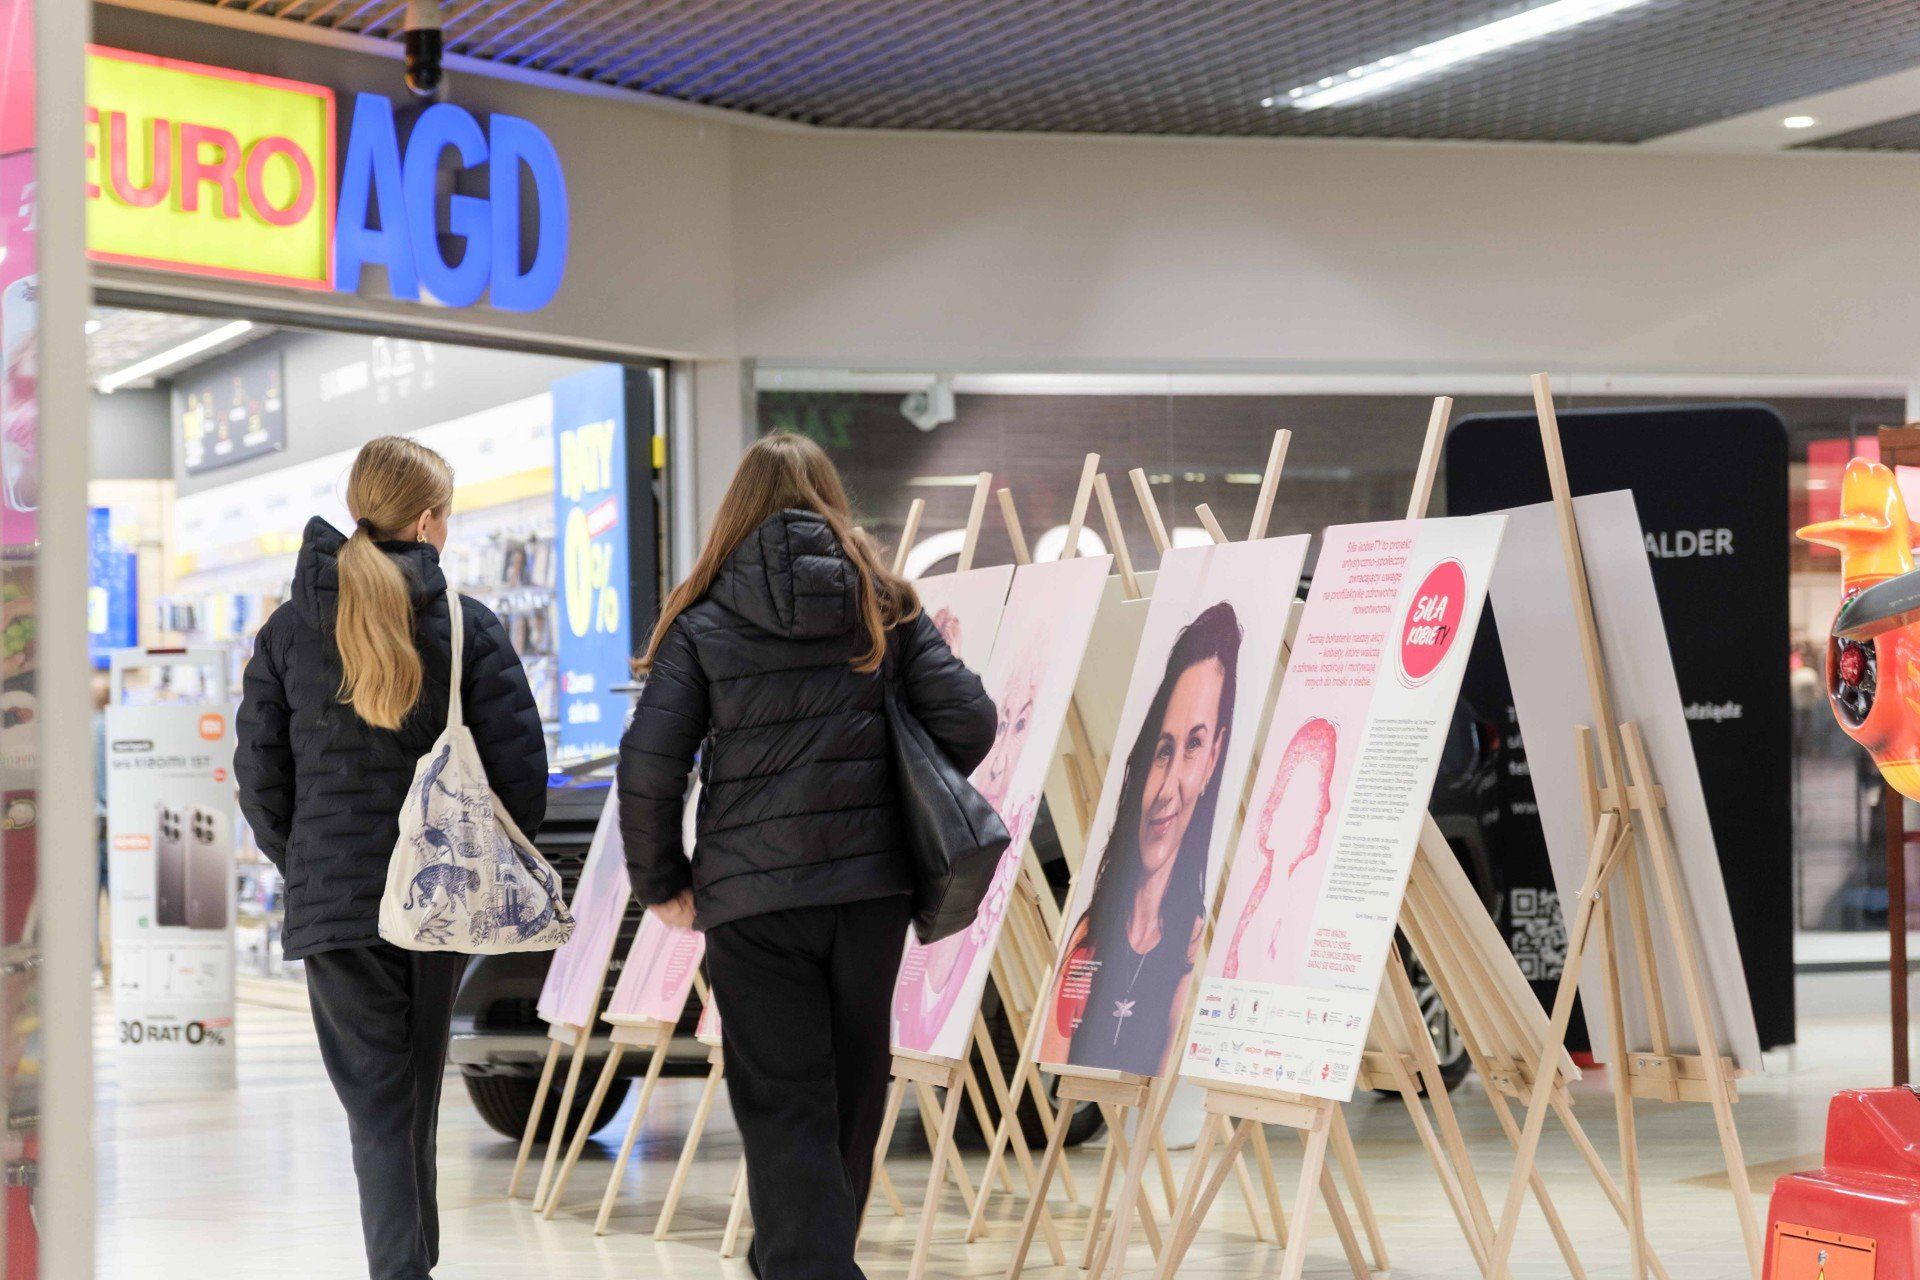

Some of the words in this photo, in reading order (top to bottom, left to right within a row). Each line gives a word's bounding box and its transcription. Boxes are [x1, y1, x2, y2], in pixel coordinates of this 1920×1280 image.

[334, 92, 569, 312] AGD
[1413, 594, 1449, 622] SIŁA
[148, 1025, 183, 1042] RAT
